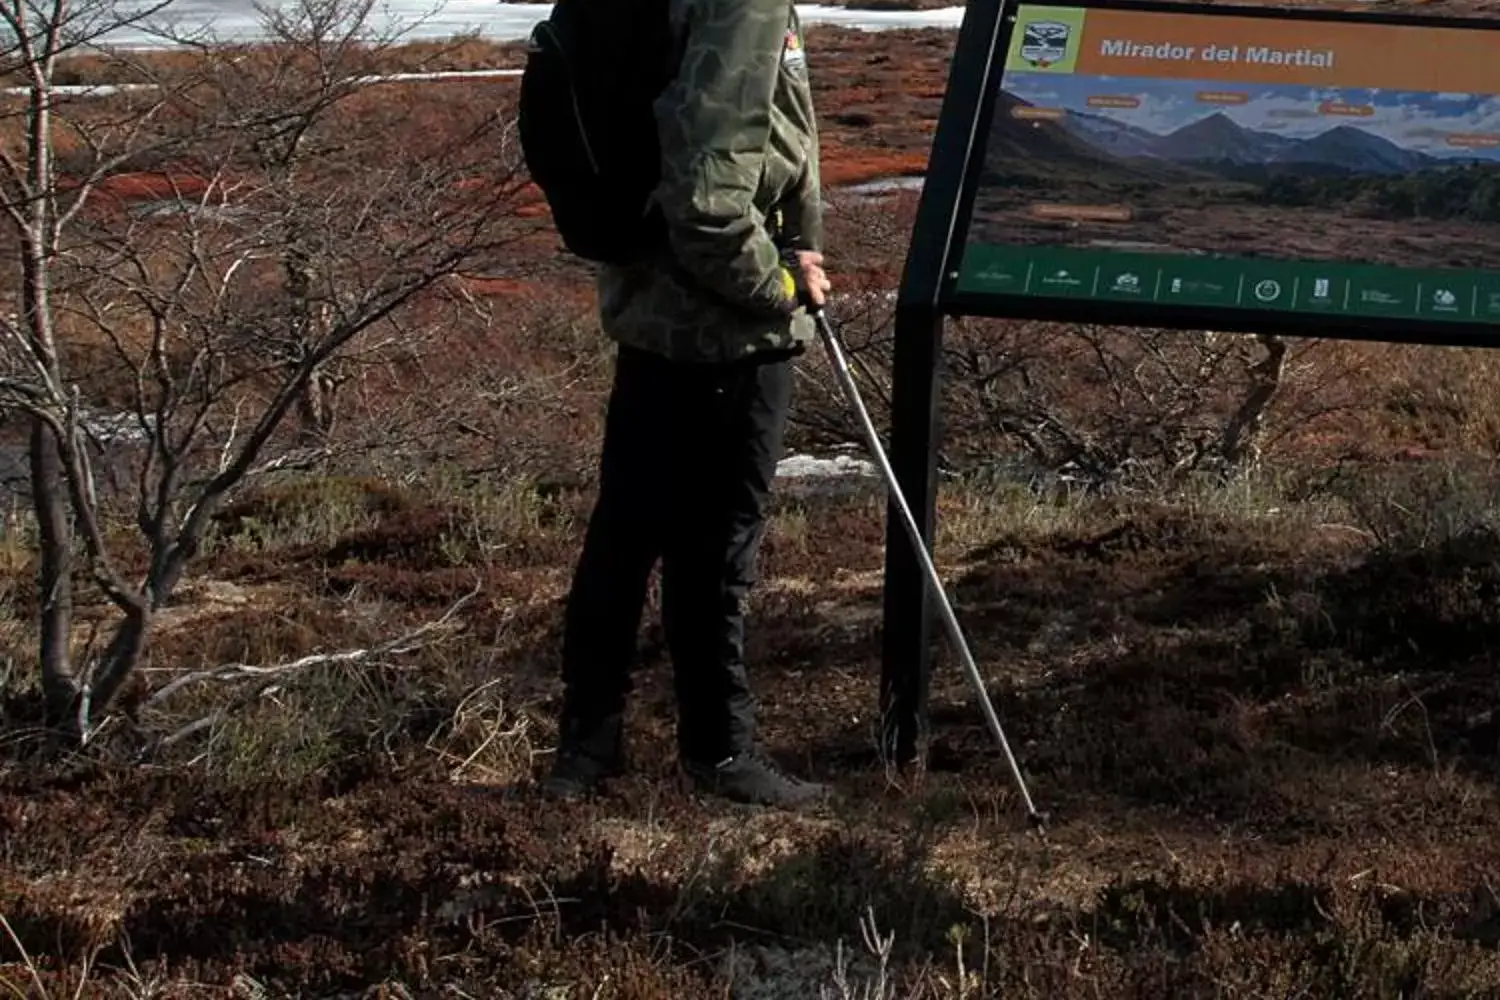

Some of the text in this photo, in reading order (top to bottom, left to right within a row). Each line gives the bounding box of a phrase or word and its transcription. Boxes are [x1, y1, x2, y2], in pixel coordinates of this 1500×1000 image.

[1100, 39, 1334, 67] Mirador del Martial
